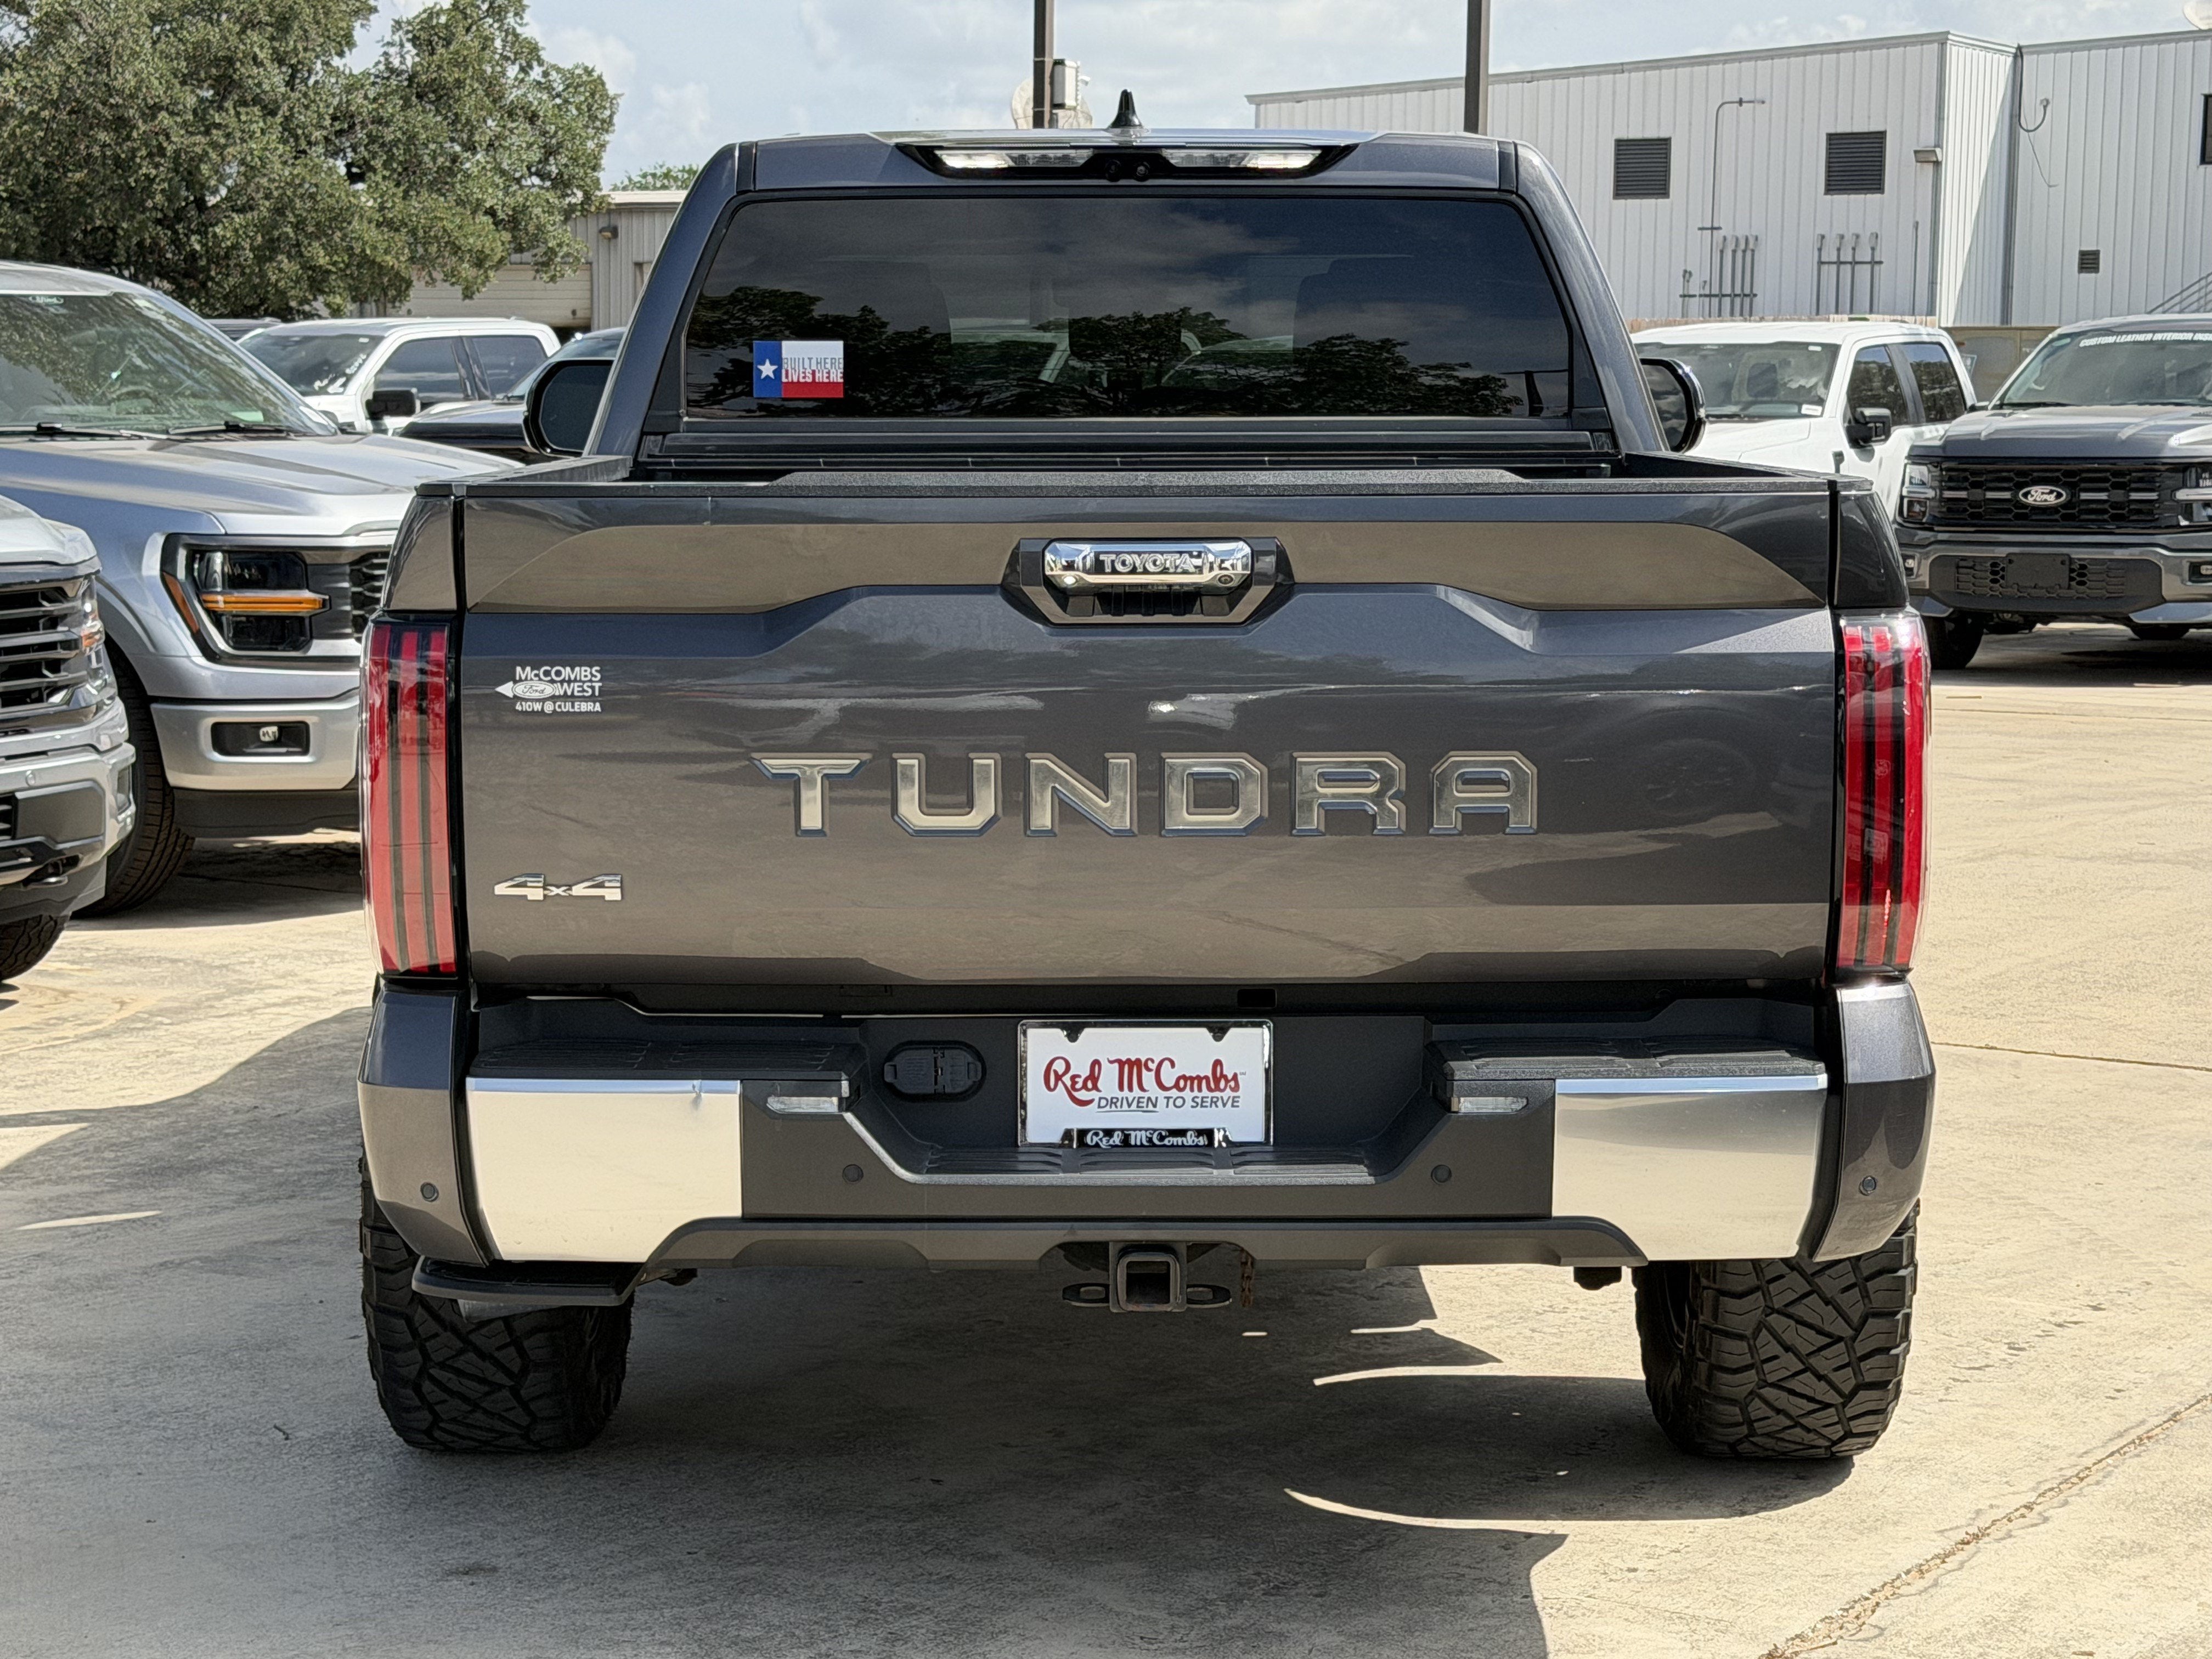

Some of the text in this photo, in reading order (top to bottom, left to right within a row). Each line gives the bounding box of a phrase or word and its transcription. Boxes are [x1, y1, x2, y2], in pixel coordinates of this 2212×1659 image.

[783, 357, 843, 370] BUILT HERE
[782, 369, 844, 382] LIVES HERE
[2028, 489, 2057, 501] Ford
[1099, 554, 1195, 573] TOYOTA
[515, 665, 601, 681] McCOMBS
[522, 685, 546, 695] Ford
[558, 682, 602, 697] WEST
[749, 752, 1538, 837] TUNDRA
[494, 873, 622, 900] 4x4
[1043, 1056, 1240, 1107] Red McCombs
[1097, 1095, 1241, 1109] DRIVEN TO SERVE
[1086, 1130, 1205, 1149] Red McCombs
